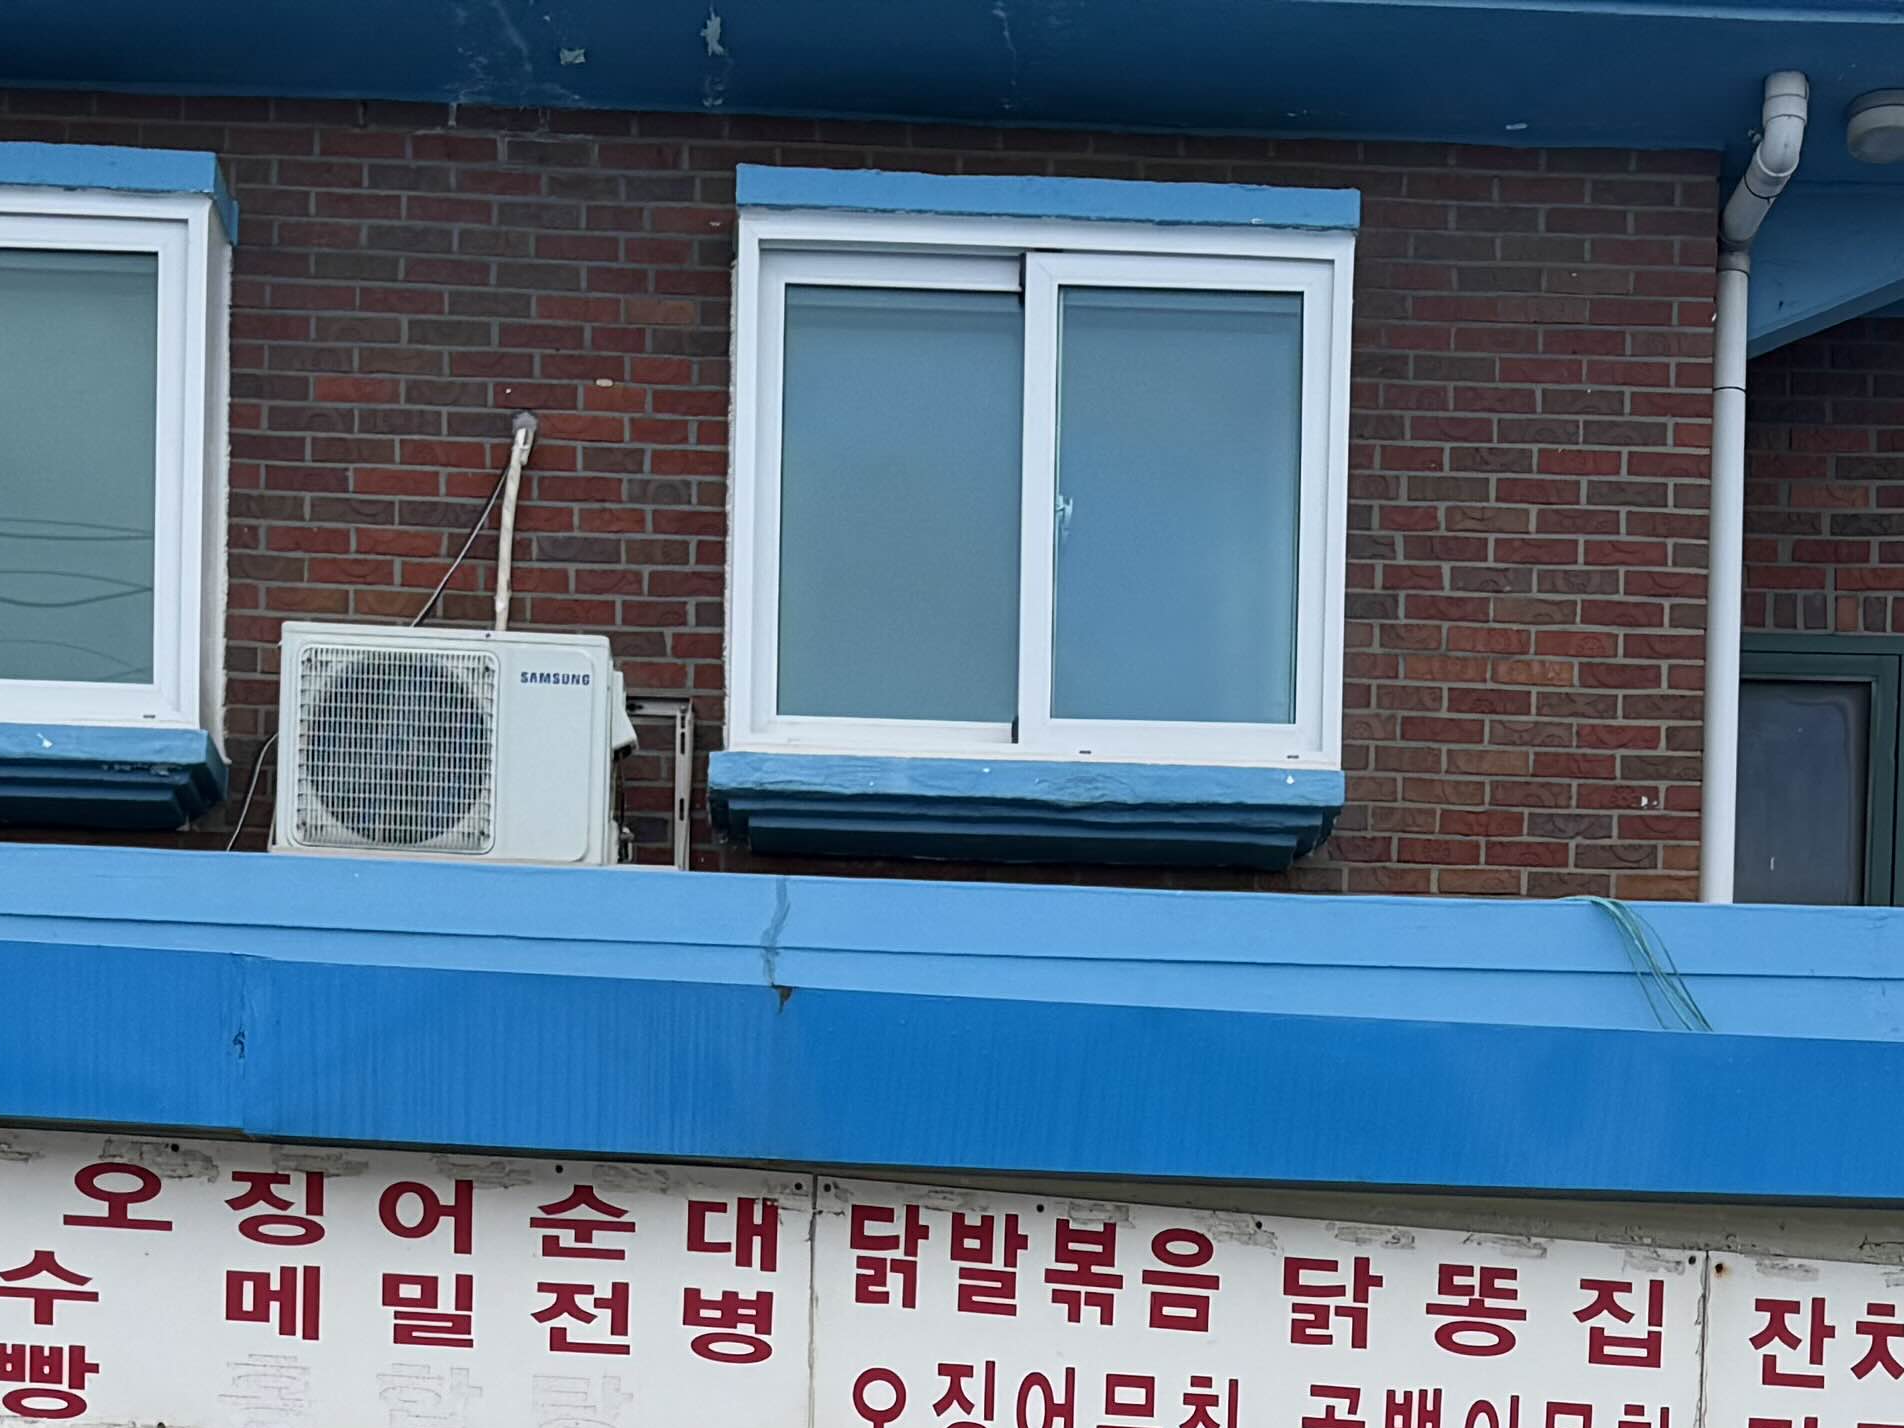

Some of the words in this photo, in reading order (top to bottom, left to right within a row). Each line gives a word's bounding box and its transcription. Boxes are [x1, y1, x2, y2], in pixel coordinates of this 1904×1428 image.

[520, 670, 591, 686] SAMSUNG
[63, 1162, 780, 1273] 오징어순대
[225, 1265, 775, 1365] 메밀전병
[849, 1204, 1220, 1333] 닭발볶음
[1283, 1256, 1665, 1369] 닭똥집
